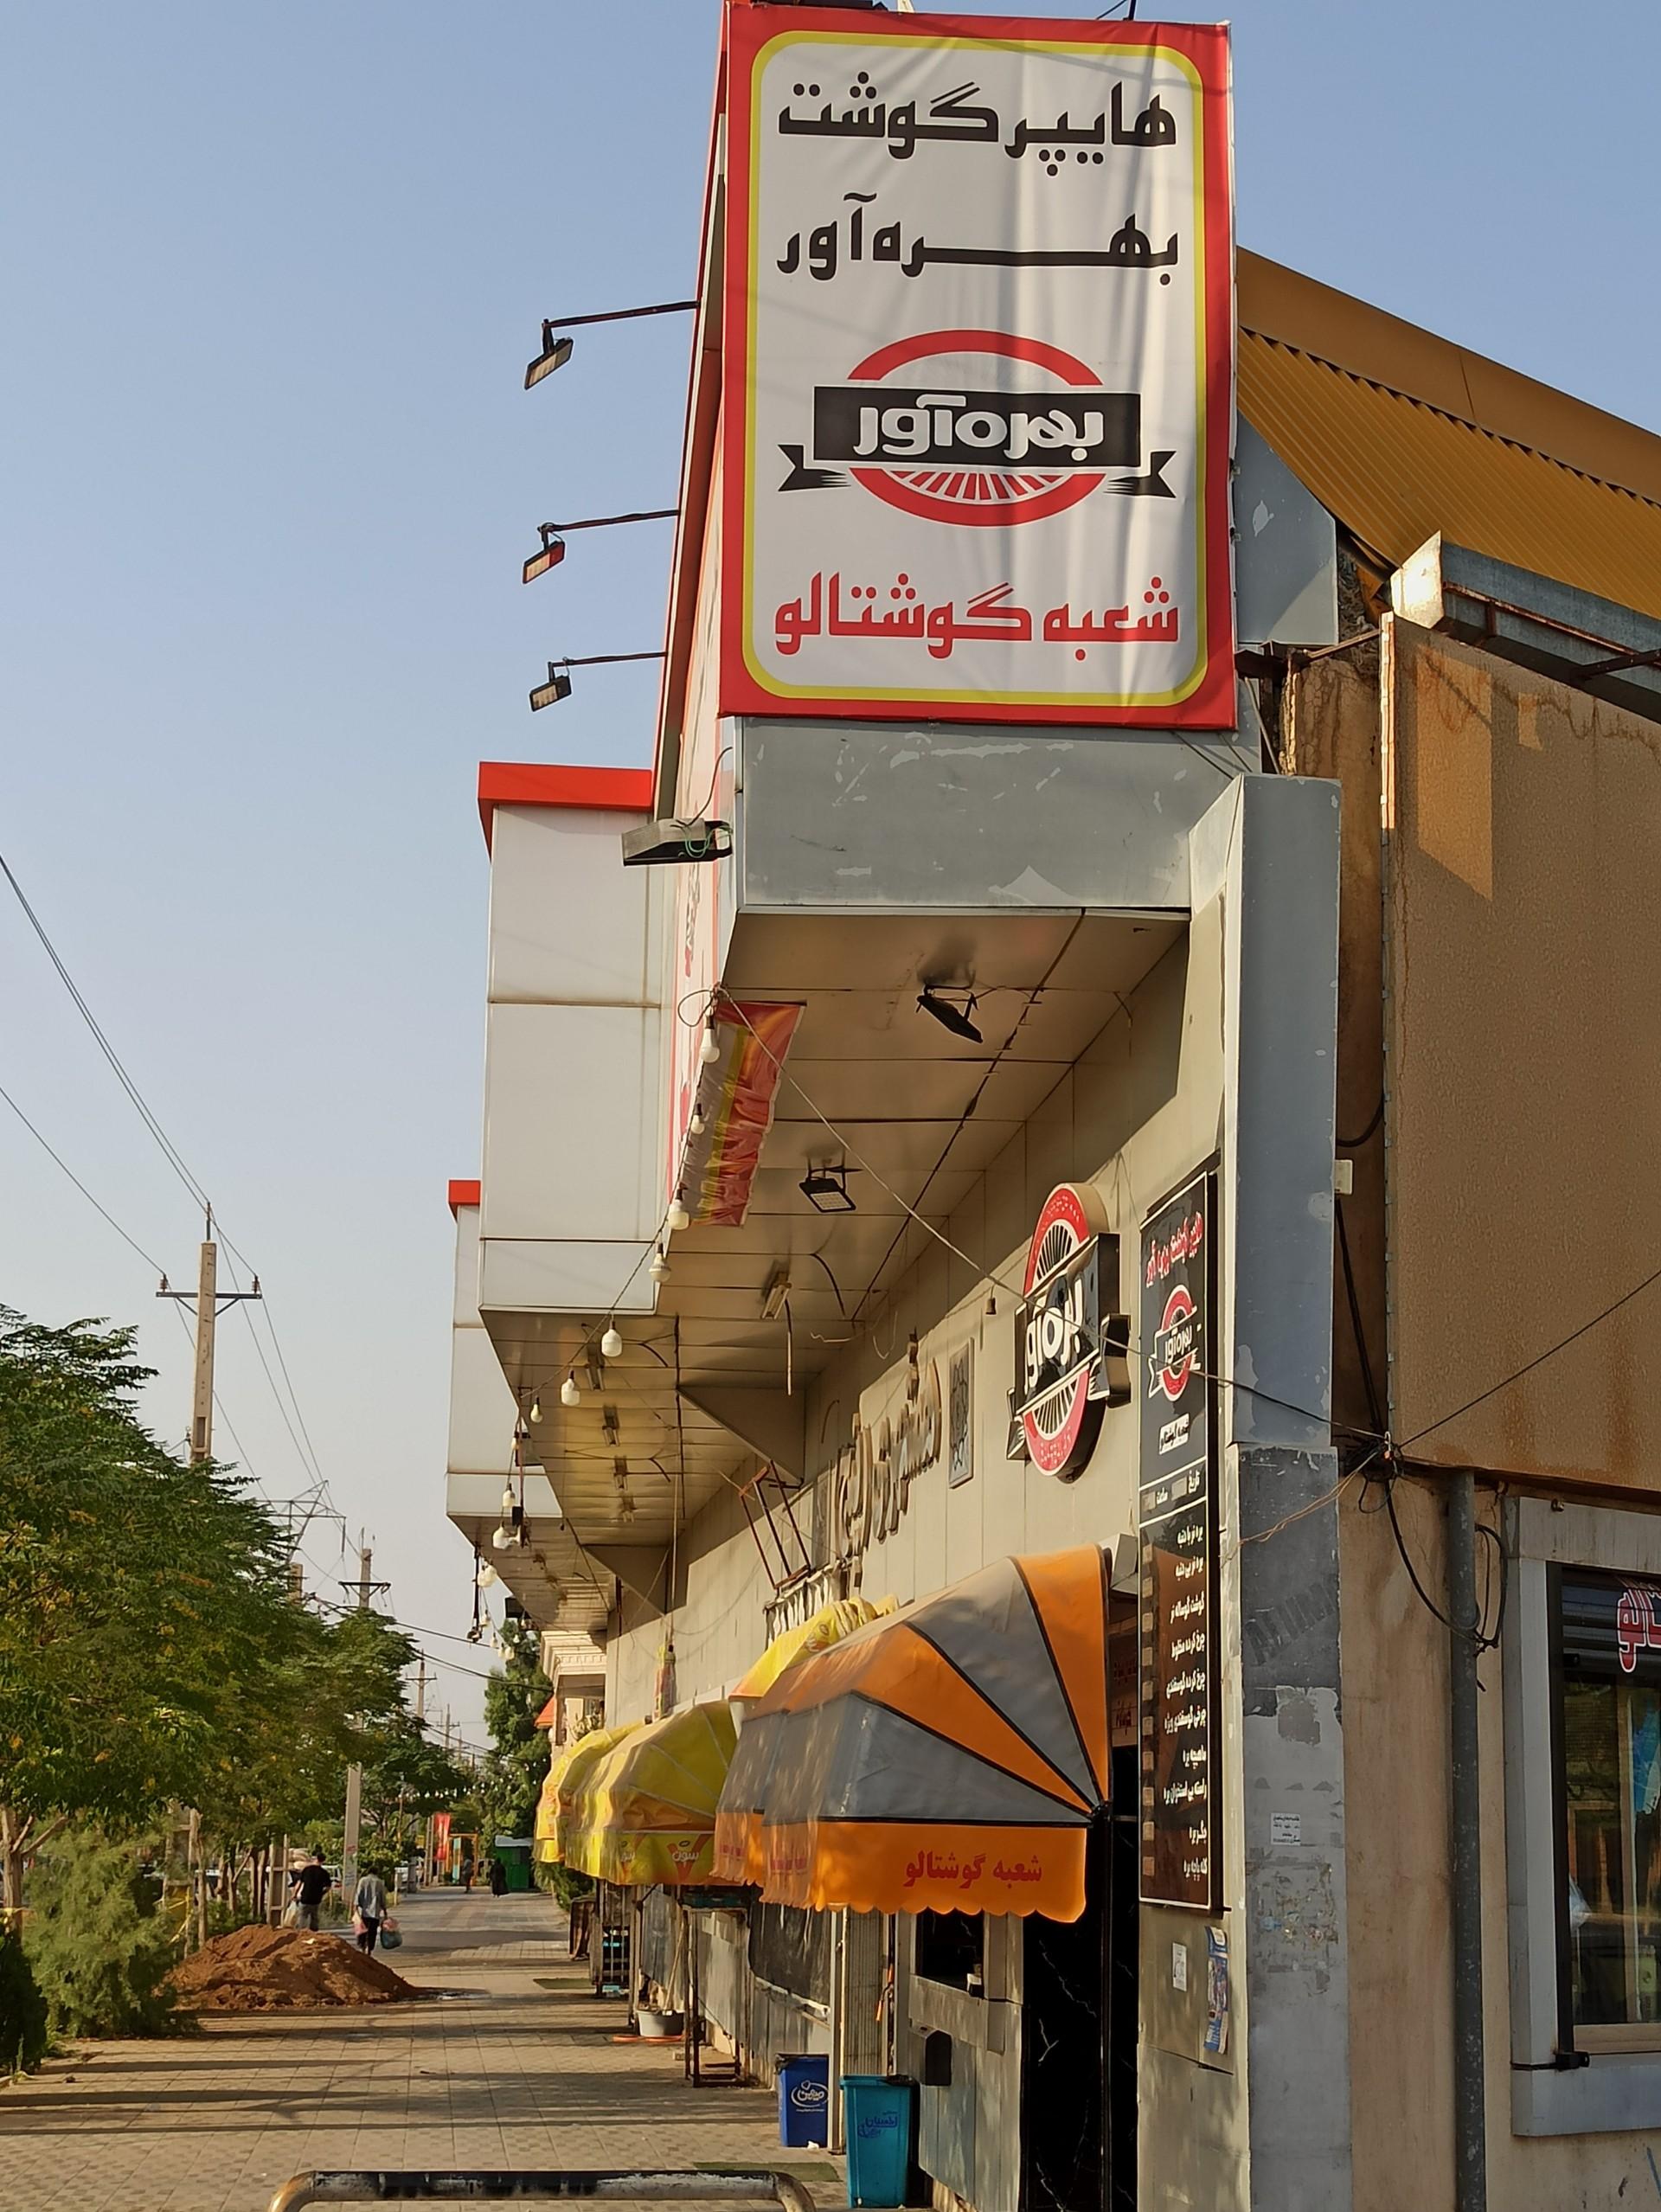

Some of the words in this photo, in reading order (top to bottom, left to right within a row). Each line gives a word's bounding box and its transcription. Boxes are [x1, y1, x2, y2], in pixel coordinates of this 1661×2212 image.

[778, 71, 999, 160] گوشت
[1004, 80, 1177, 176] هایپر
[774, 570, 1033, 659] گوشتالو
[1042, 575, 1179, 662] شعبه
[902, 1850, 987, 1889] گوشتالو
[992, 1854, 1043, 1889] شعبه
